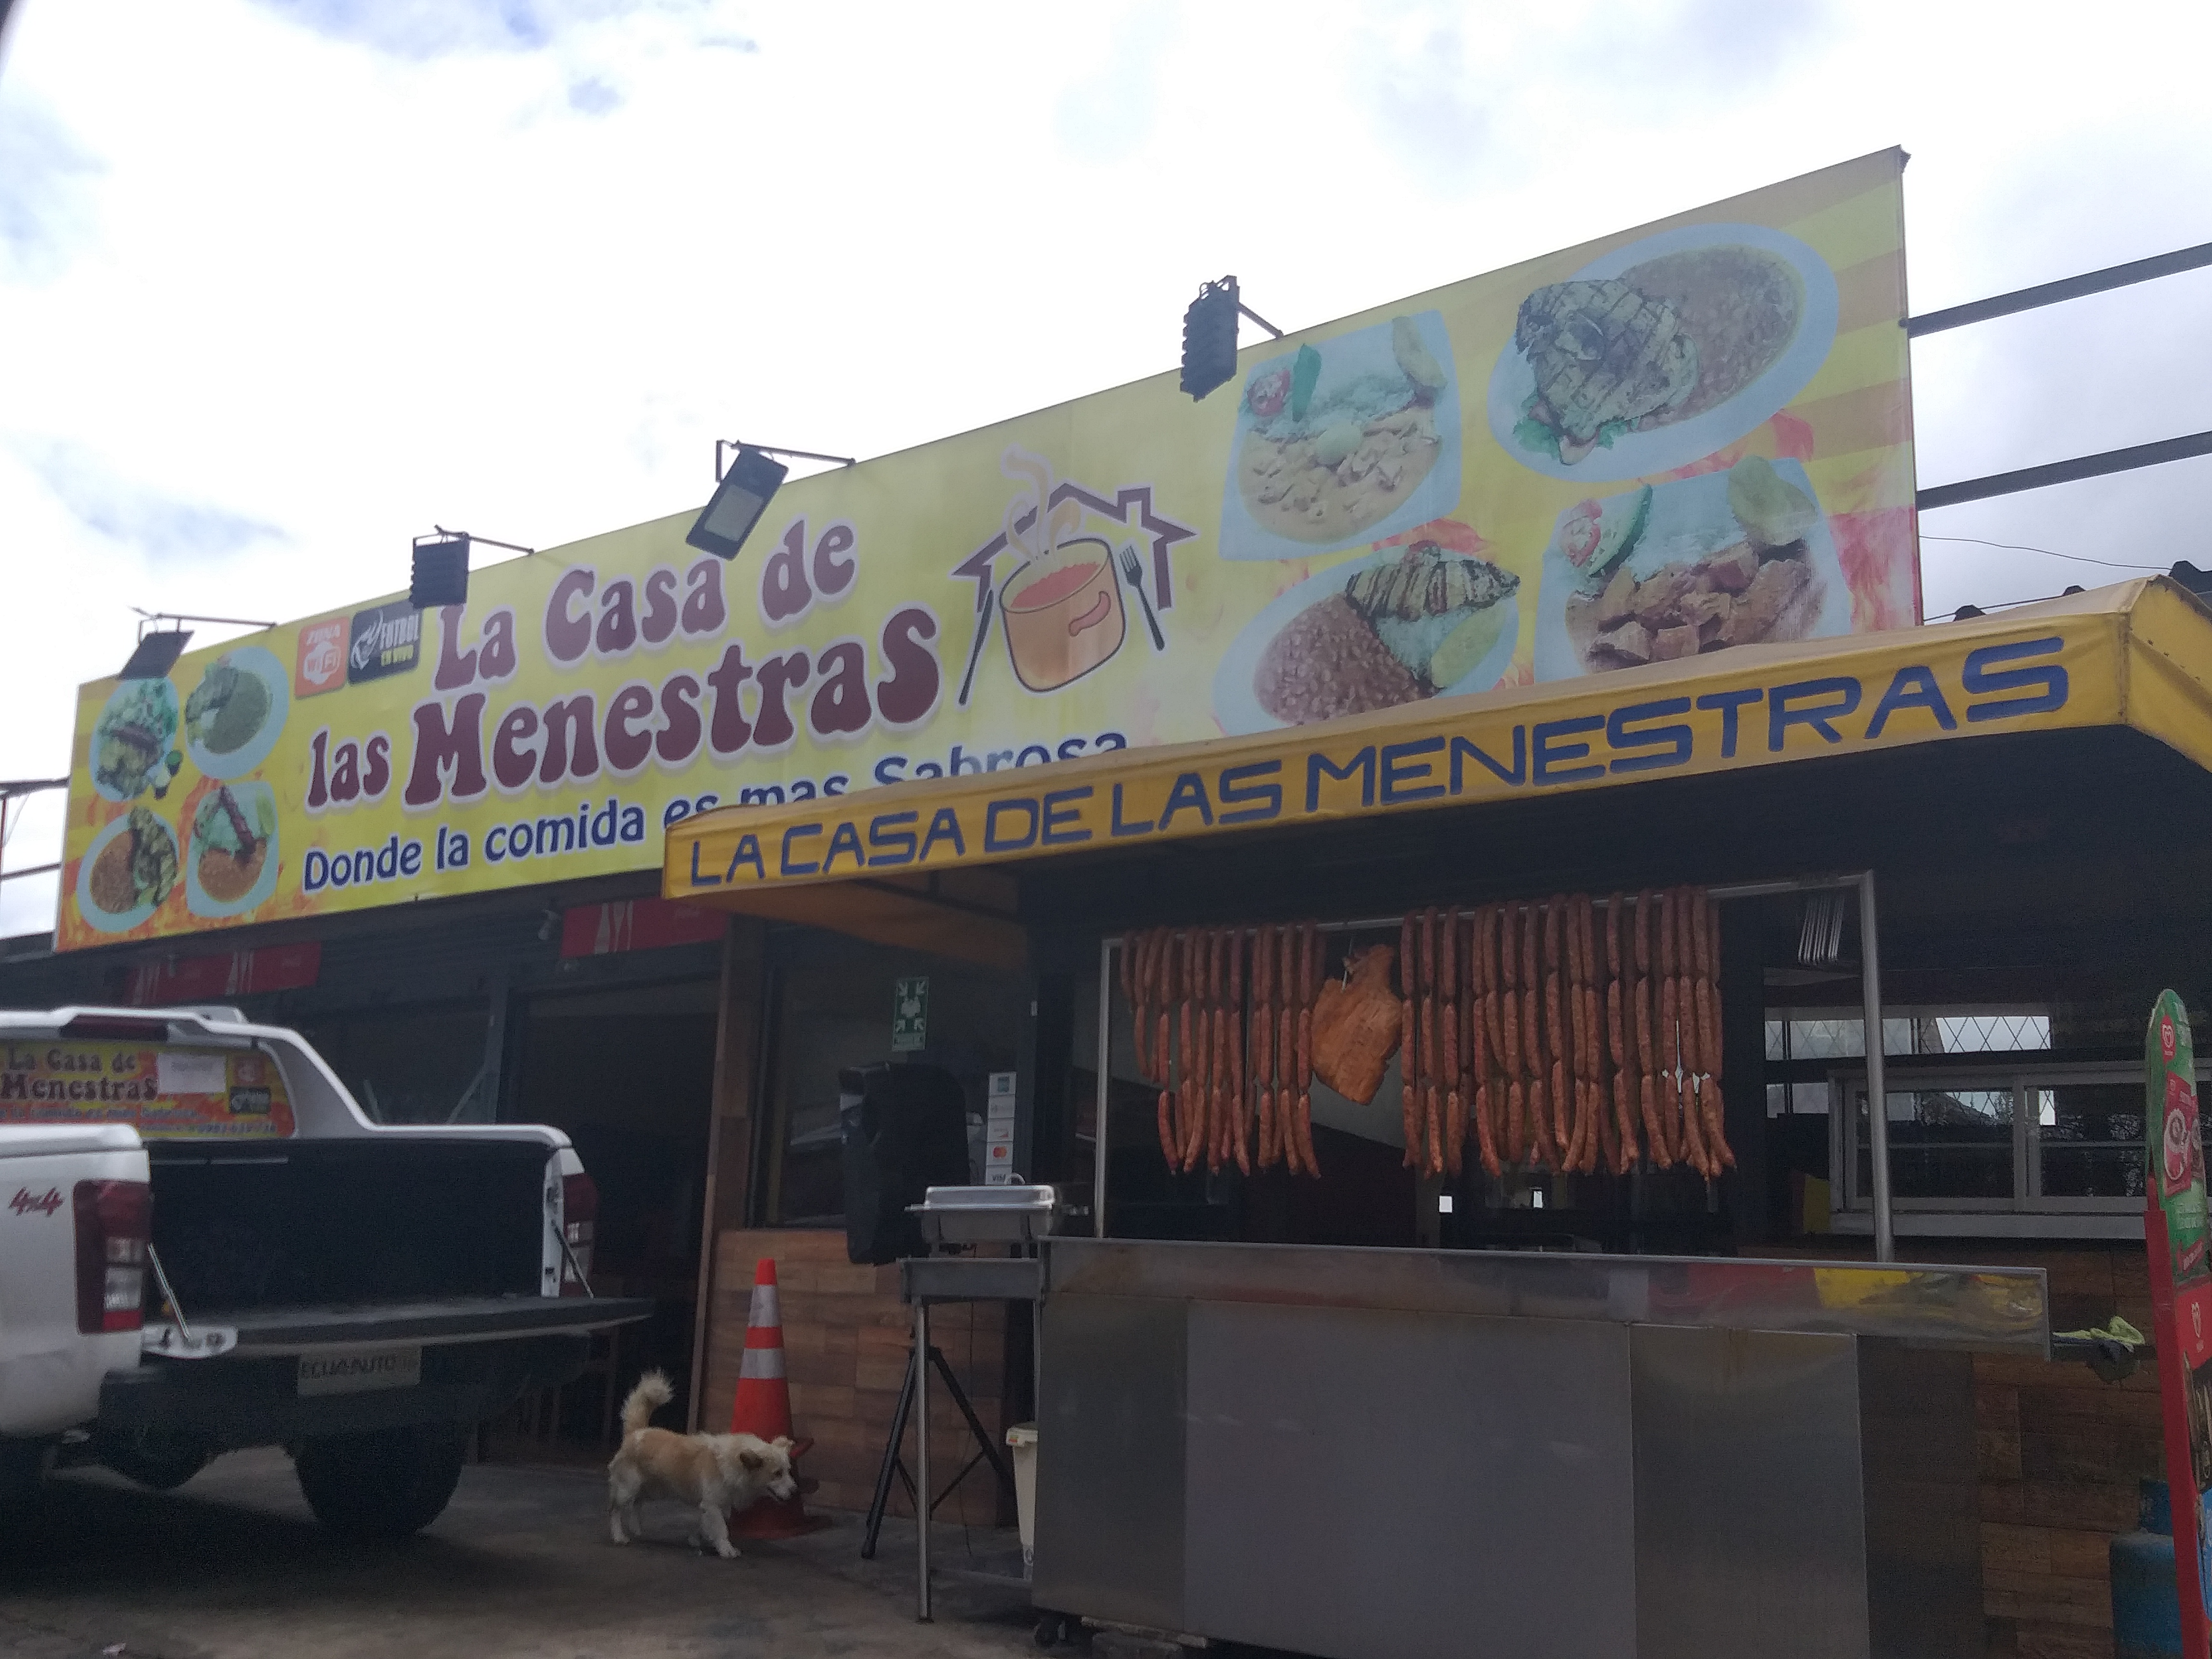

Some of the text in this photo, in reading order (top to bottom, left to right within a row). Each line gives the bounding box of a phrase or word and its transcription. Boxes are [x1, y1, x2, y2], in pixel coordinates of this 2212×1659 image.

[434, 519, 855, 690] La Casa de
[307, 608, 939, 807] las Menestras
[690, 637, 2069, 886] LA CASA DE LAS MENESTRAS
[304, 836, 421, 890] Donde
[437, 827, 469, 870] la
[485, 799, 644, 861] comida
[0, 1073, 158, 1100] Menestras
[48, 1048, 102, 1071] Casa
[111, 1052, 136, 1073] de
